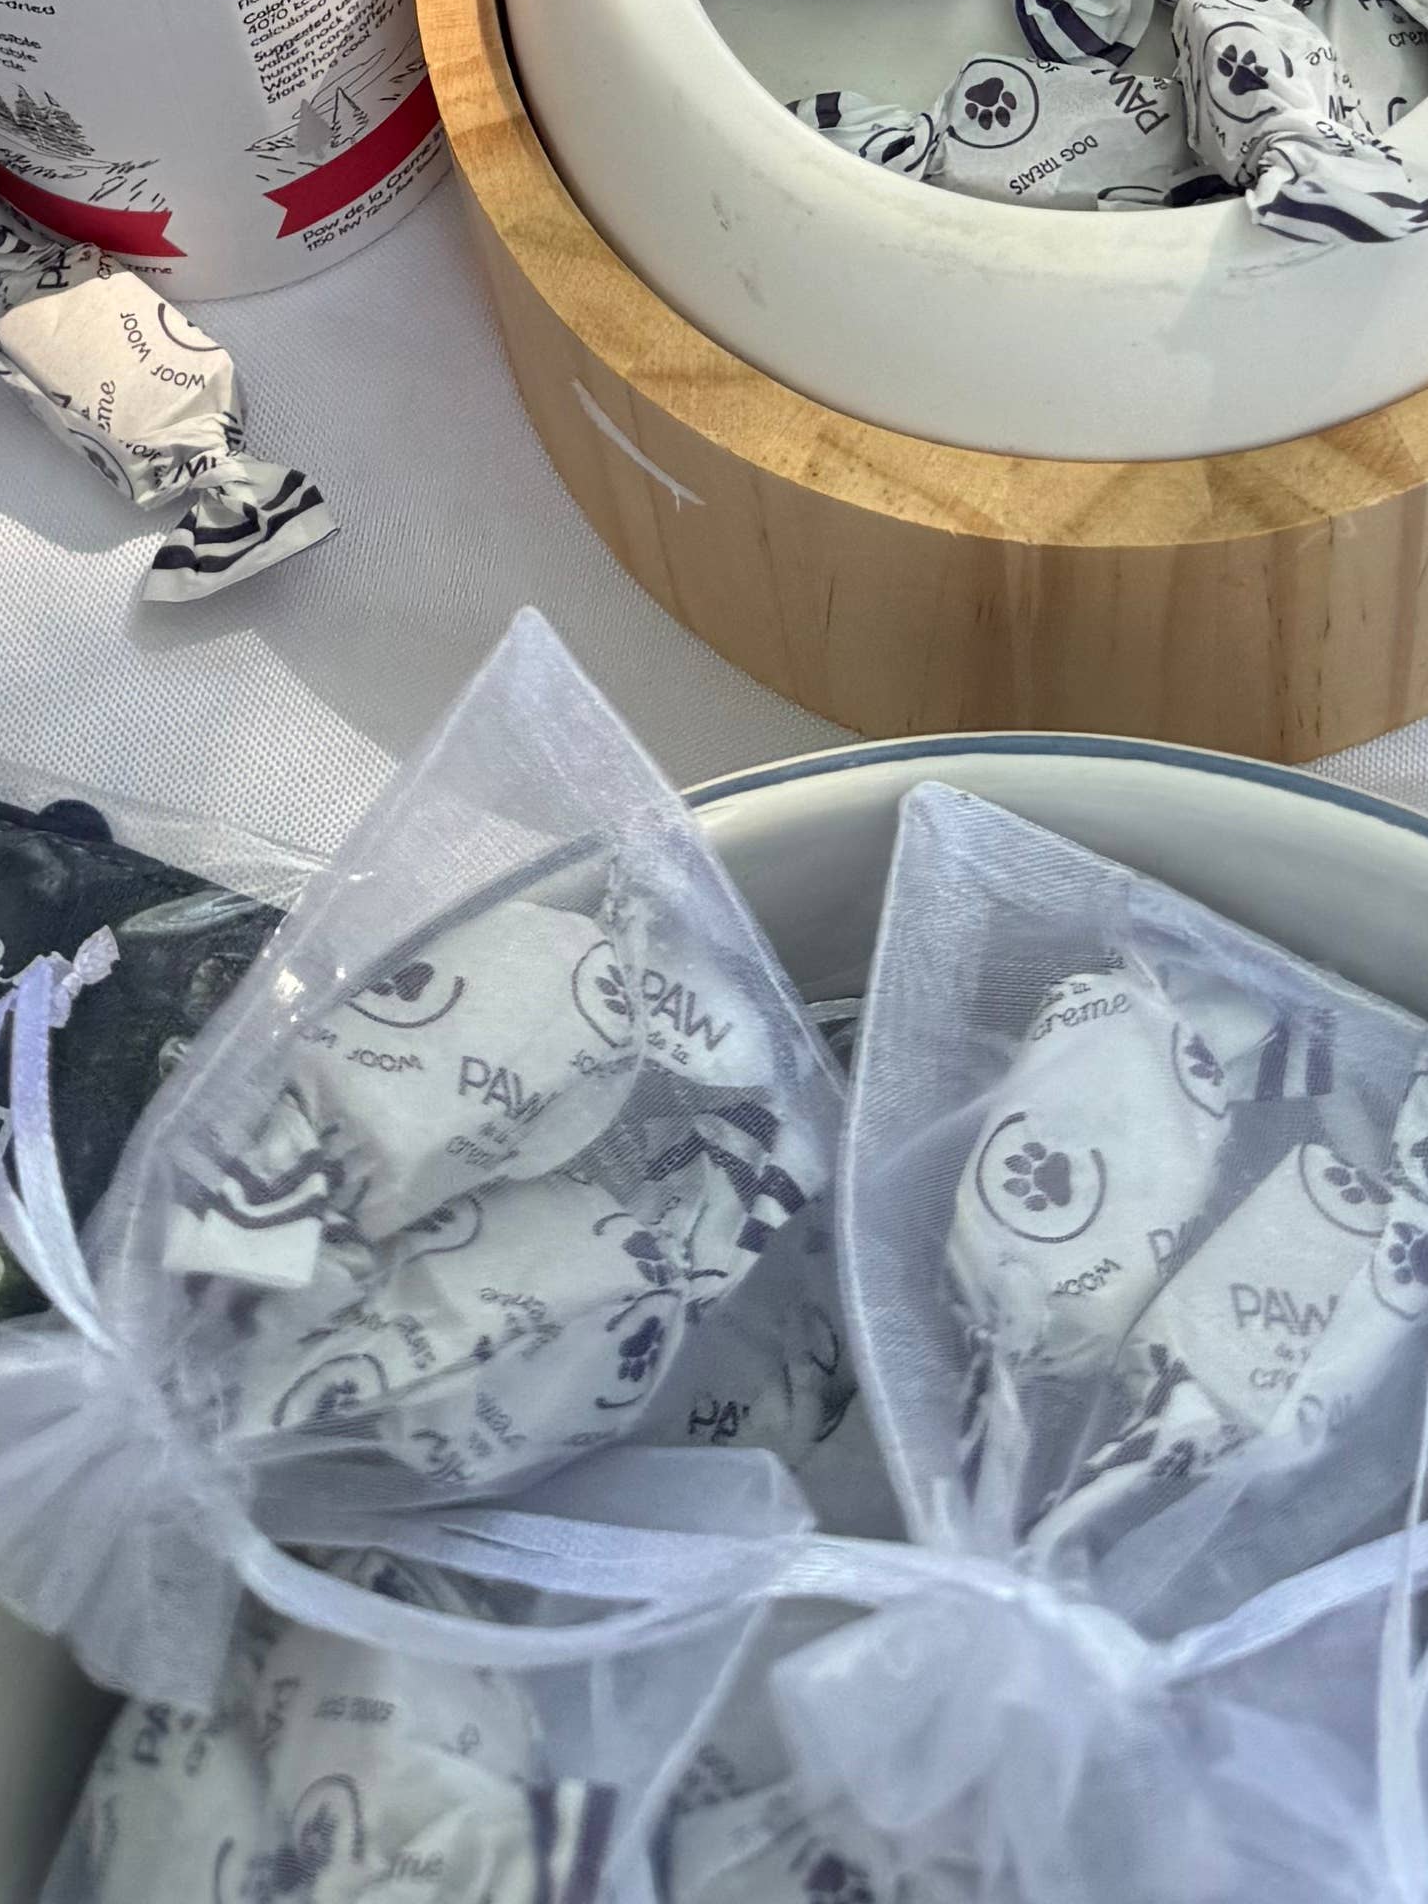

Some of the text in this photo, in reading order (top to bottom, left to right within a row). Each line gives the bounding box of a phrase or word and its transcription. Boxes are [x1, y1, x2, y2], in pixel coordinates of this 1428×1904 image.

[1008, 133, 1098, 197] DOG TREATS
[120, 312, 206, 390] WOOF WOOF
[640, 968, 734, 1050] PAW
